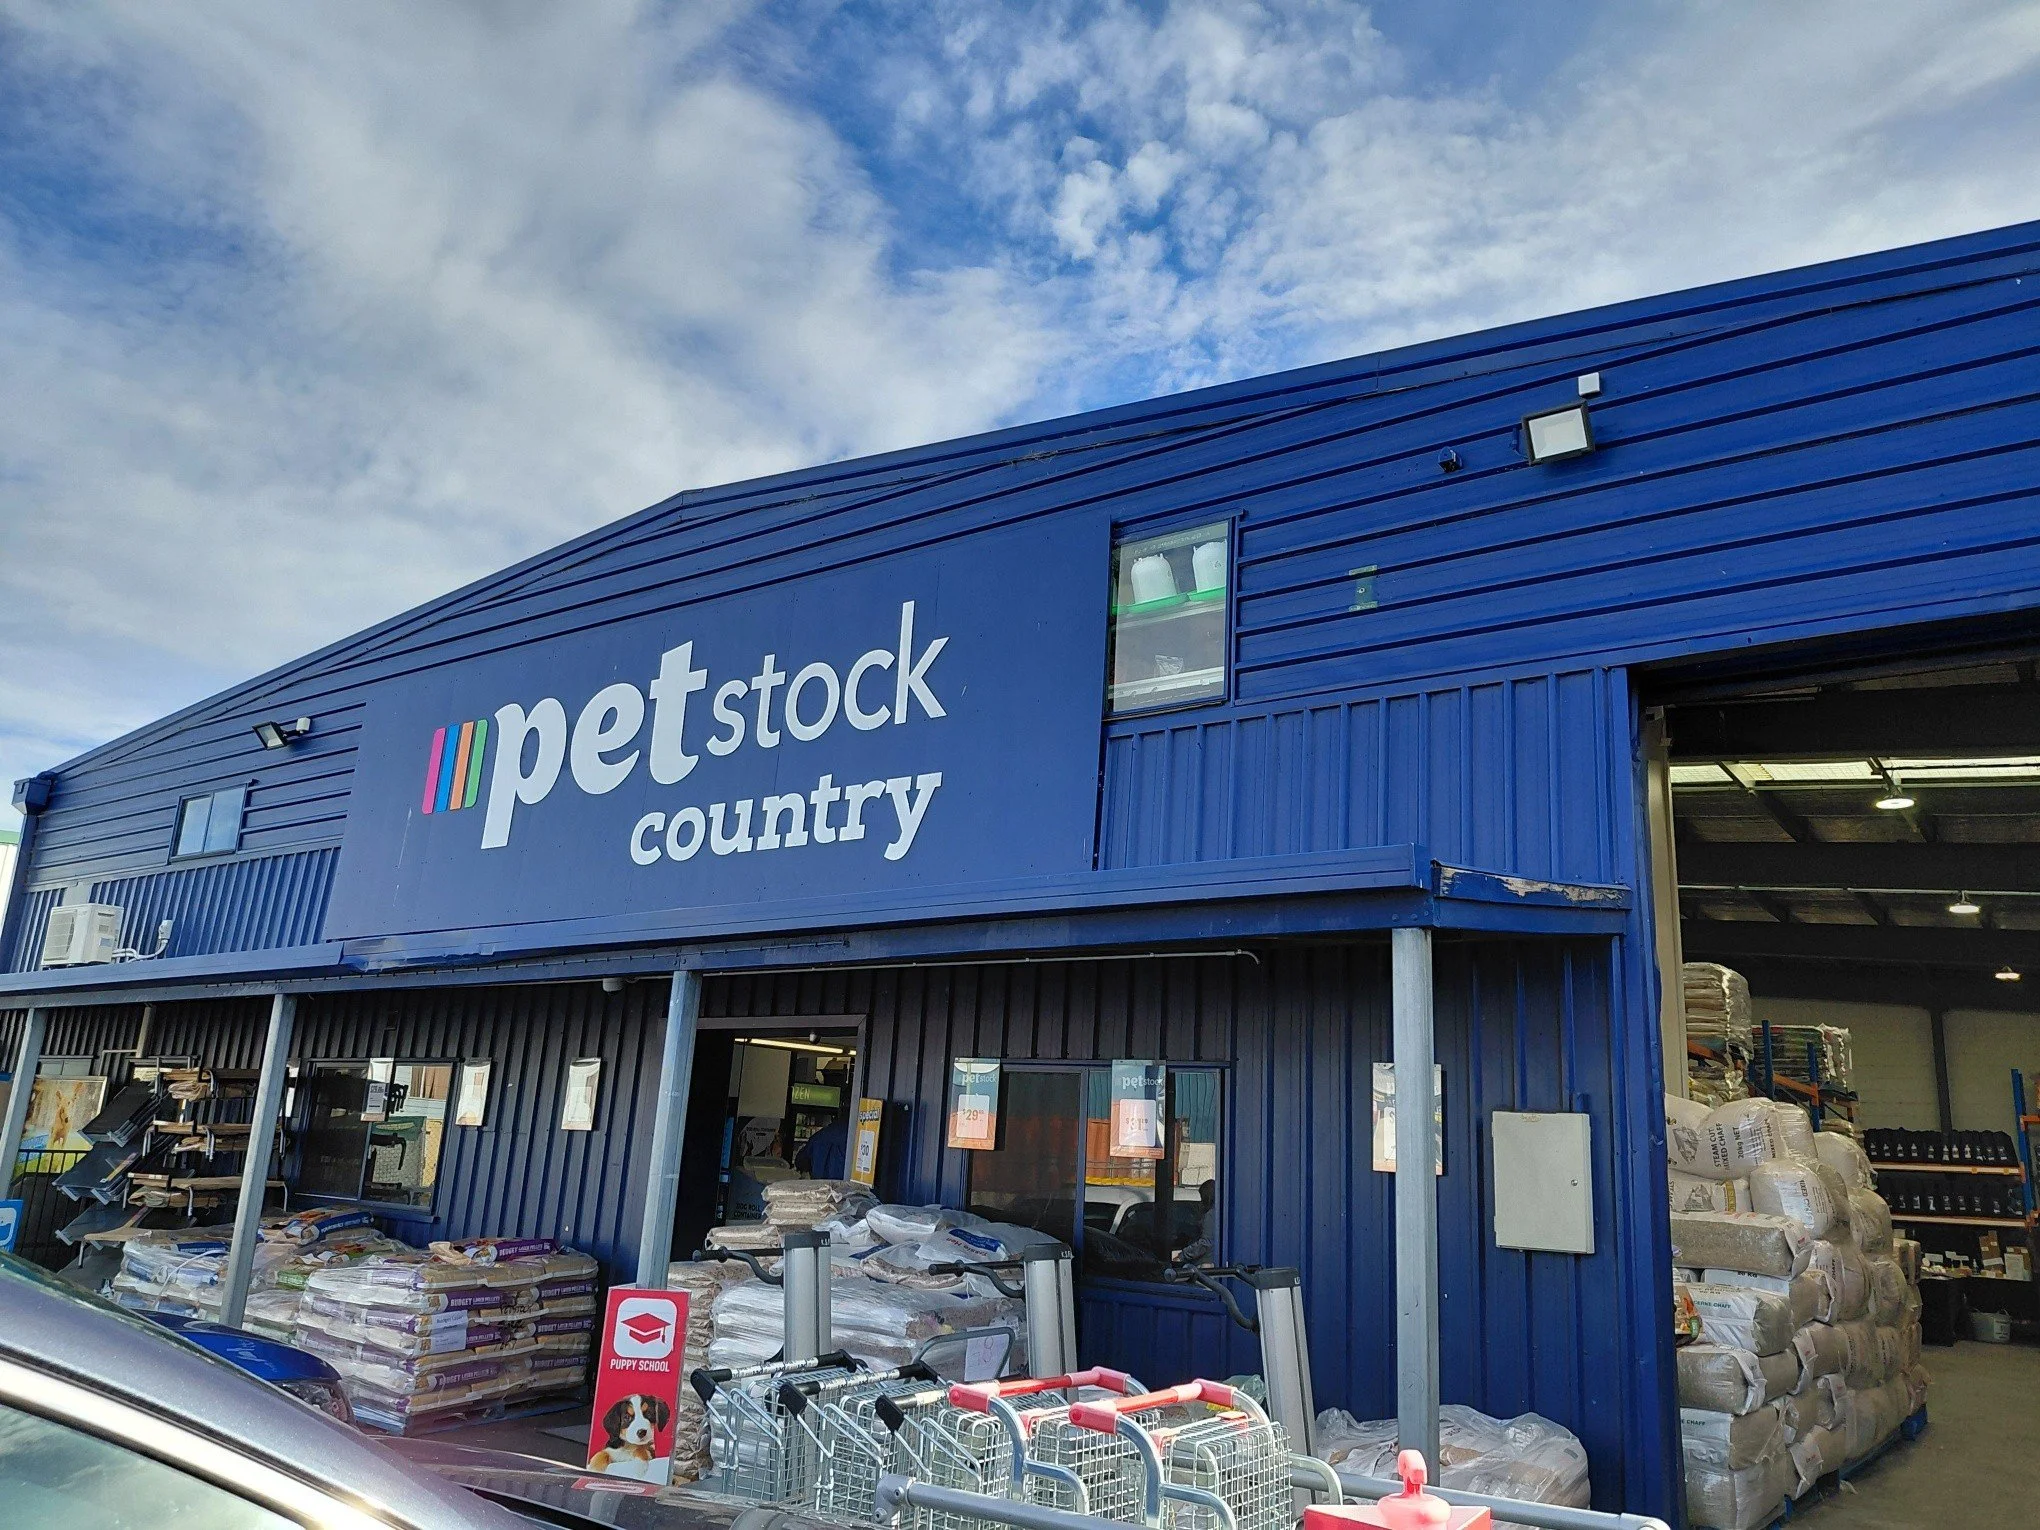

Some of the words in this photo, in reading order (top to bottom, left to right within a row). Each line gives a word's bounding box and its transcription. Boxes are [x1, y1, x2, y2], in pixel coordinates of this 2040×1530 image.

[629, 771, 943, 865] country
[1708, 1129, 1717, 1142] CUT
[1716, 1122, 1726, 1147] CHAFF
[1732, 1127, 1741, 1140] NET
[1710, 1143, 1722, 1168] STEAM
[1721, 1146, 1731, 1171] MIXED
[609, 1358, 638, 1371] PUPPY
[638, 1360, 671, 1373] SCHOOL
